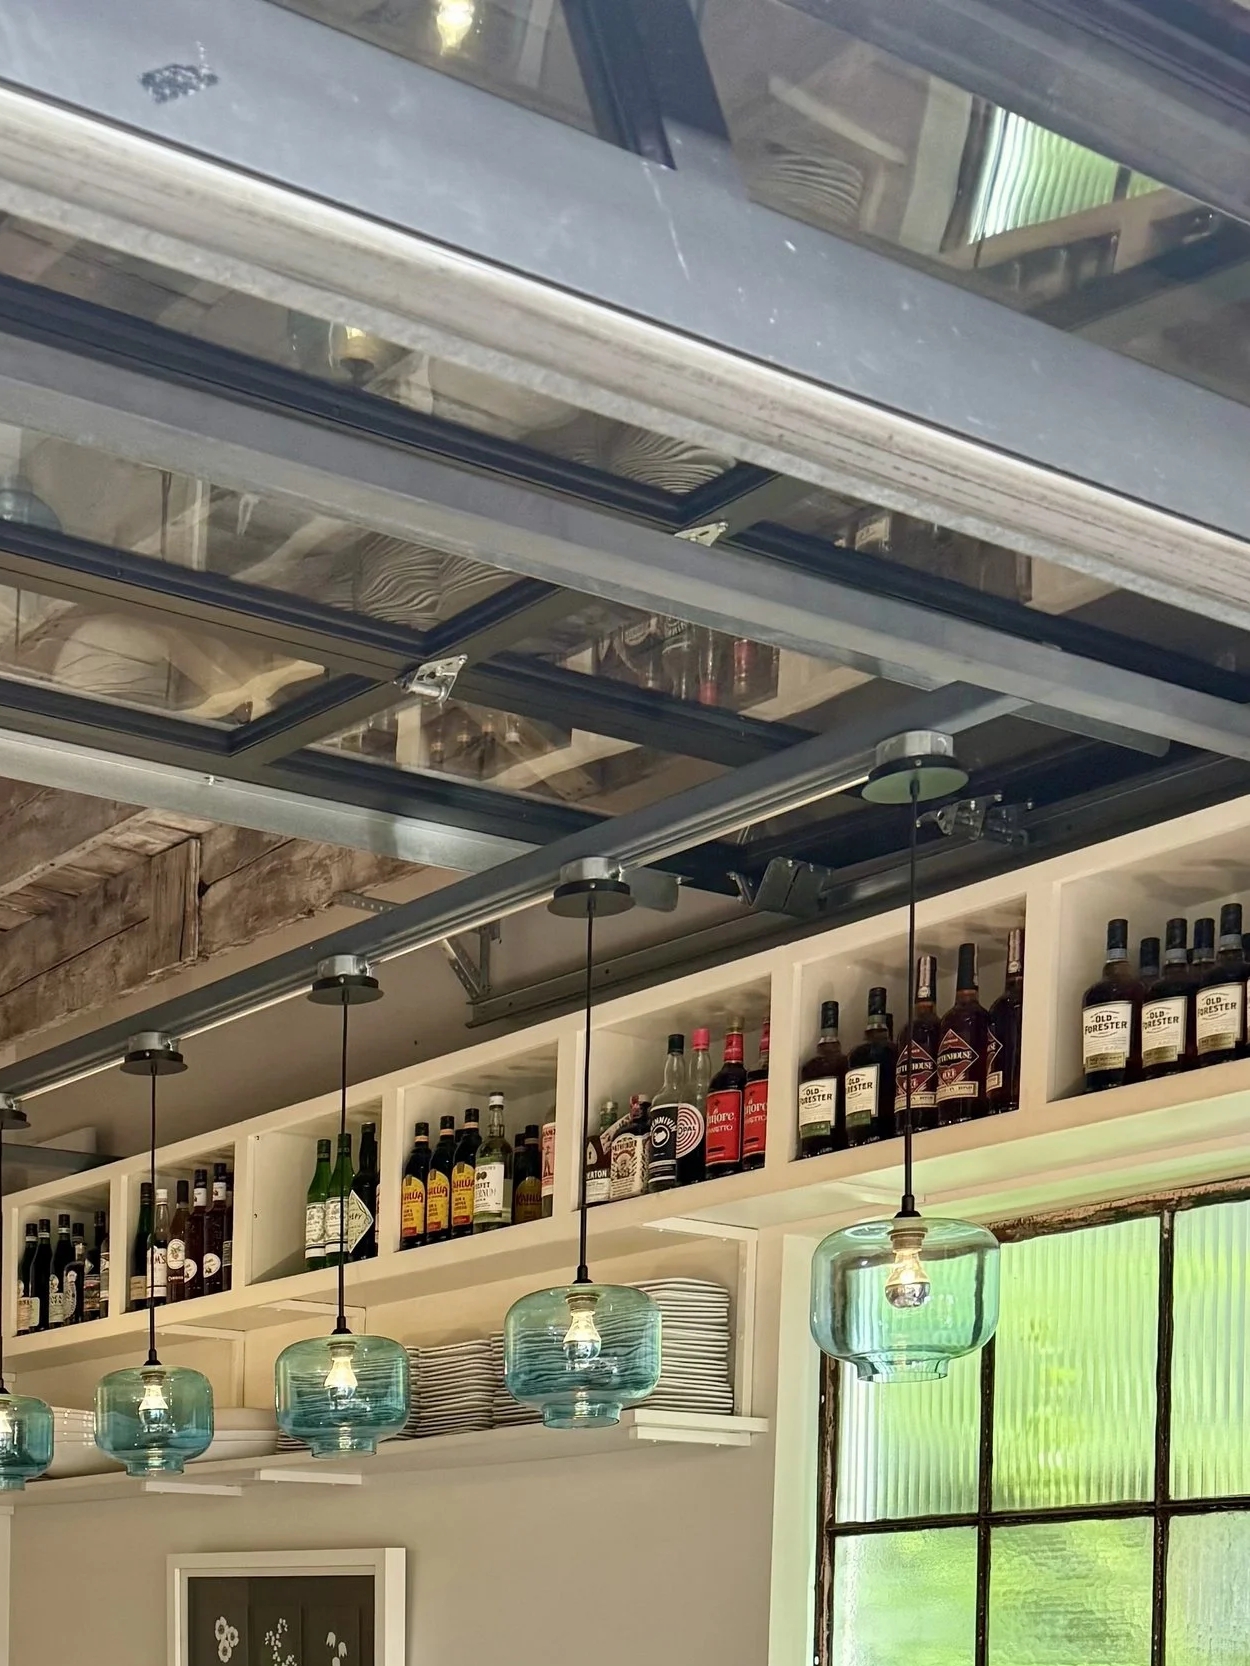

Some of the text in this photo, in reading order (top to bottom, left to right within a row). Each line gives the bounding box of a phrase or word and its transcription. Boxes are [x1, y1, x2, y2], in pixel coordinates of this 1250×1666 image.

[1206, 997, 1221, 1005] OLD
[1095, 1015, 1112, 1023] OLD
[1150, 1011, 1164, 1019] OLD
[1085, 1021, 1127, 1034] FORESTER
[806, 1088, 819, 1096] OLD
